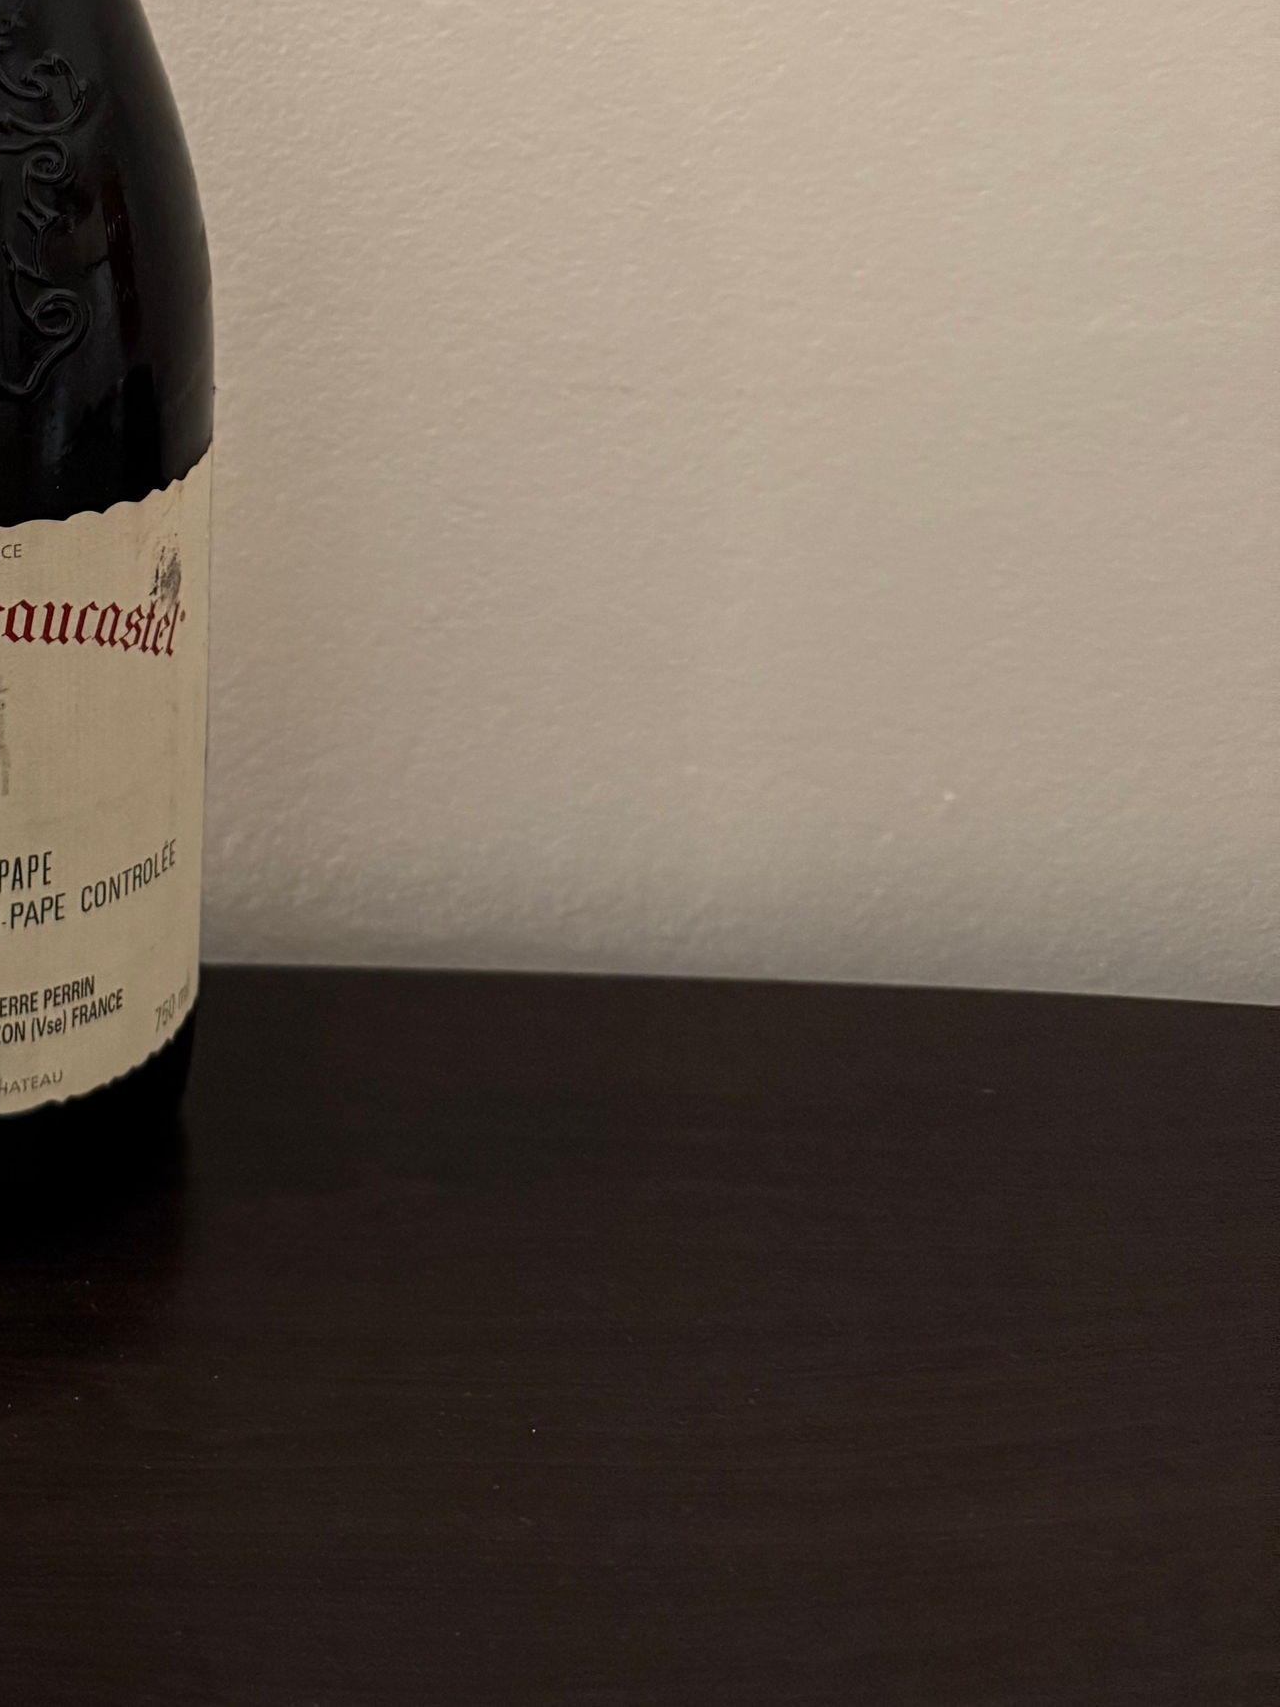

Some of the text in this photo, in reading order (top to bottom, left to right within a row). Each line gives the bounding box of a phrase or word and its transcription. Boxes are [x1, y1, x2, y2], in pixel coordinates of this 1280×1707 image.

[80, 837, 177, 913] CONTROLÉE
[31, 1008, 67, 1043] (Vse)
[71, 988, 123, 1028] FRANCE
[43, 975, 96, 1010] PERRIN
[155, 993, 175, 1033] 750
